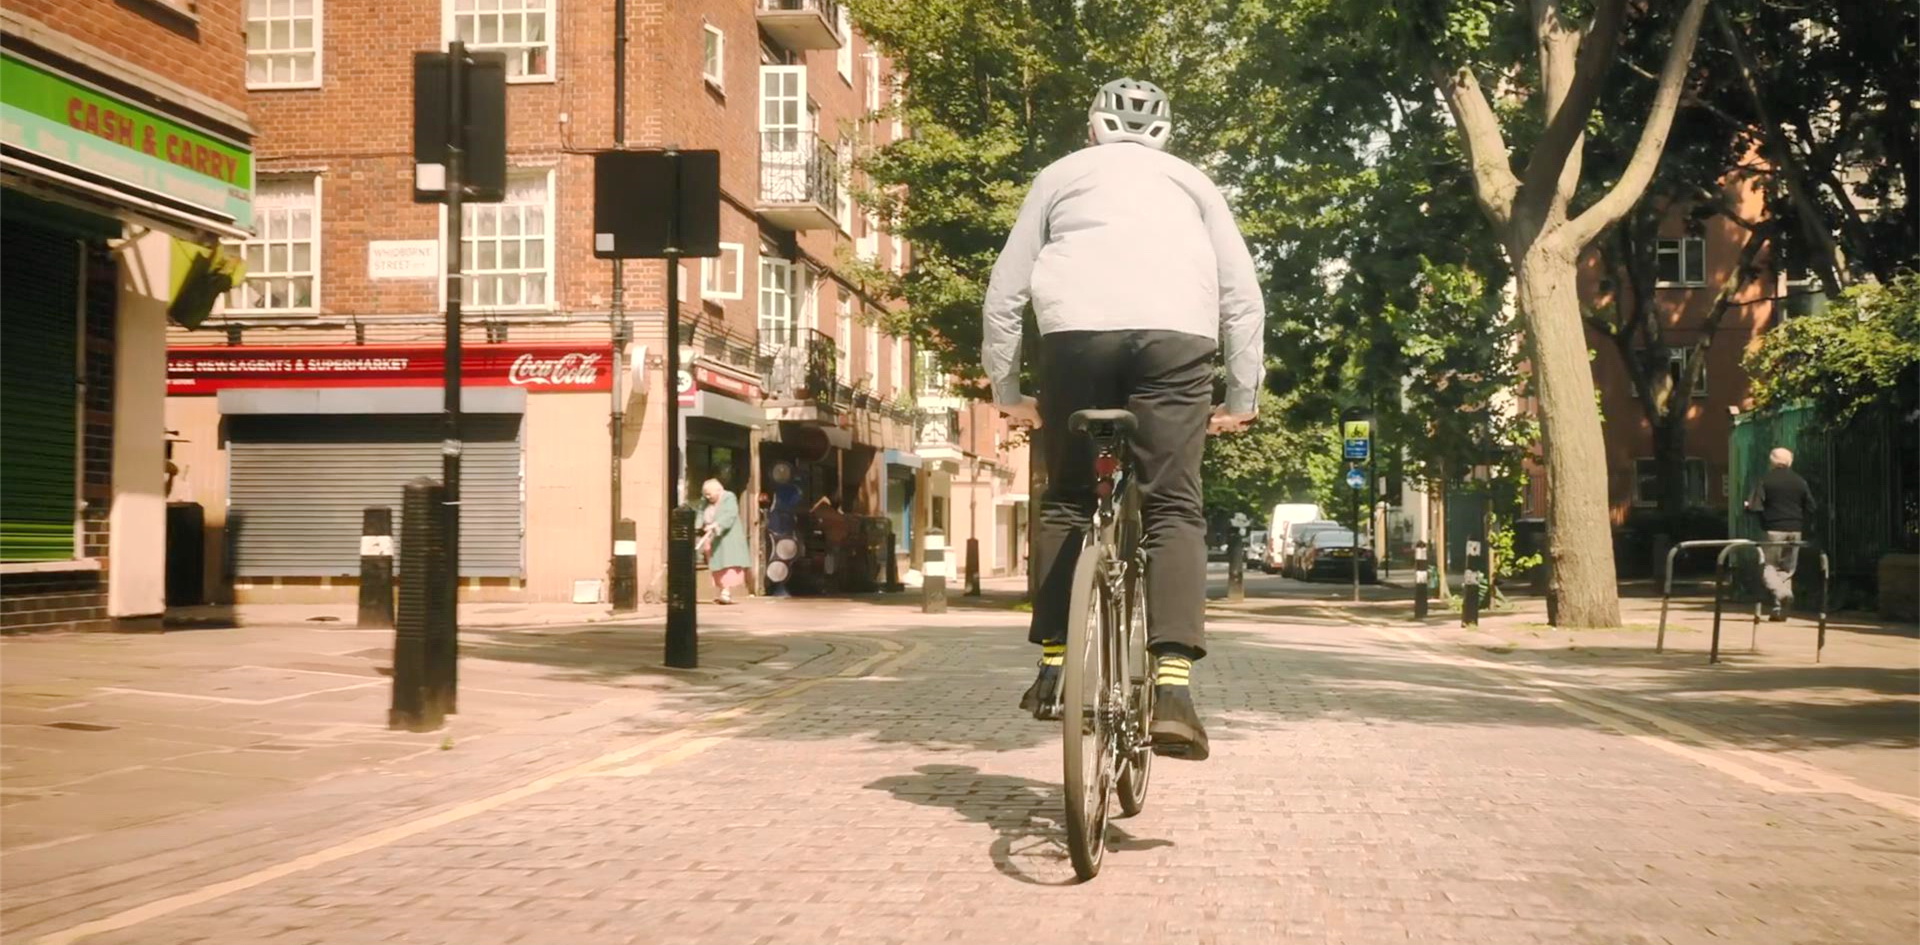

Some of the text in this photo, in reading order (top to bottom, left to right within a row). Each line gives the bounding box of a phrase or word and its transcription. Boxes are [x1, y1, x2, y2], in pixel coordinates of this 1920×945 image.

[67, 97, 135, 149] CASH
[141, 125, 158, 157] &
[166, 134, 238, 184] CARRY
[374, 260, 409, 270] STREET
[197, 359, 291, 372] NEWSAGENTS
[295, 359, 305, 371] &
[308, 358, 409, 371] SUPERMARKET
